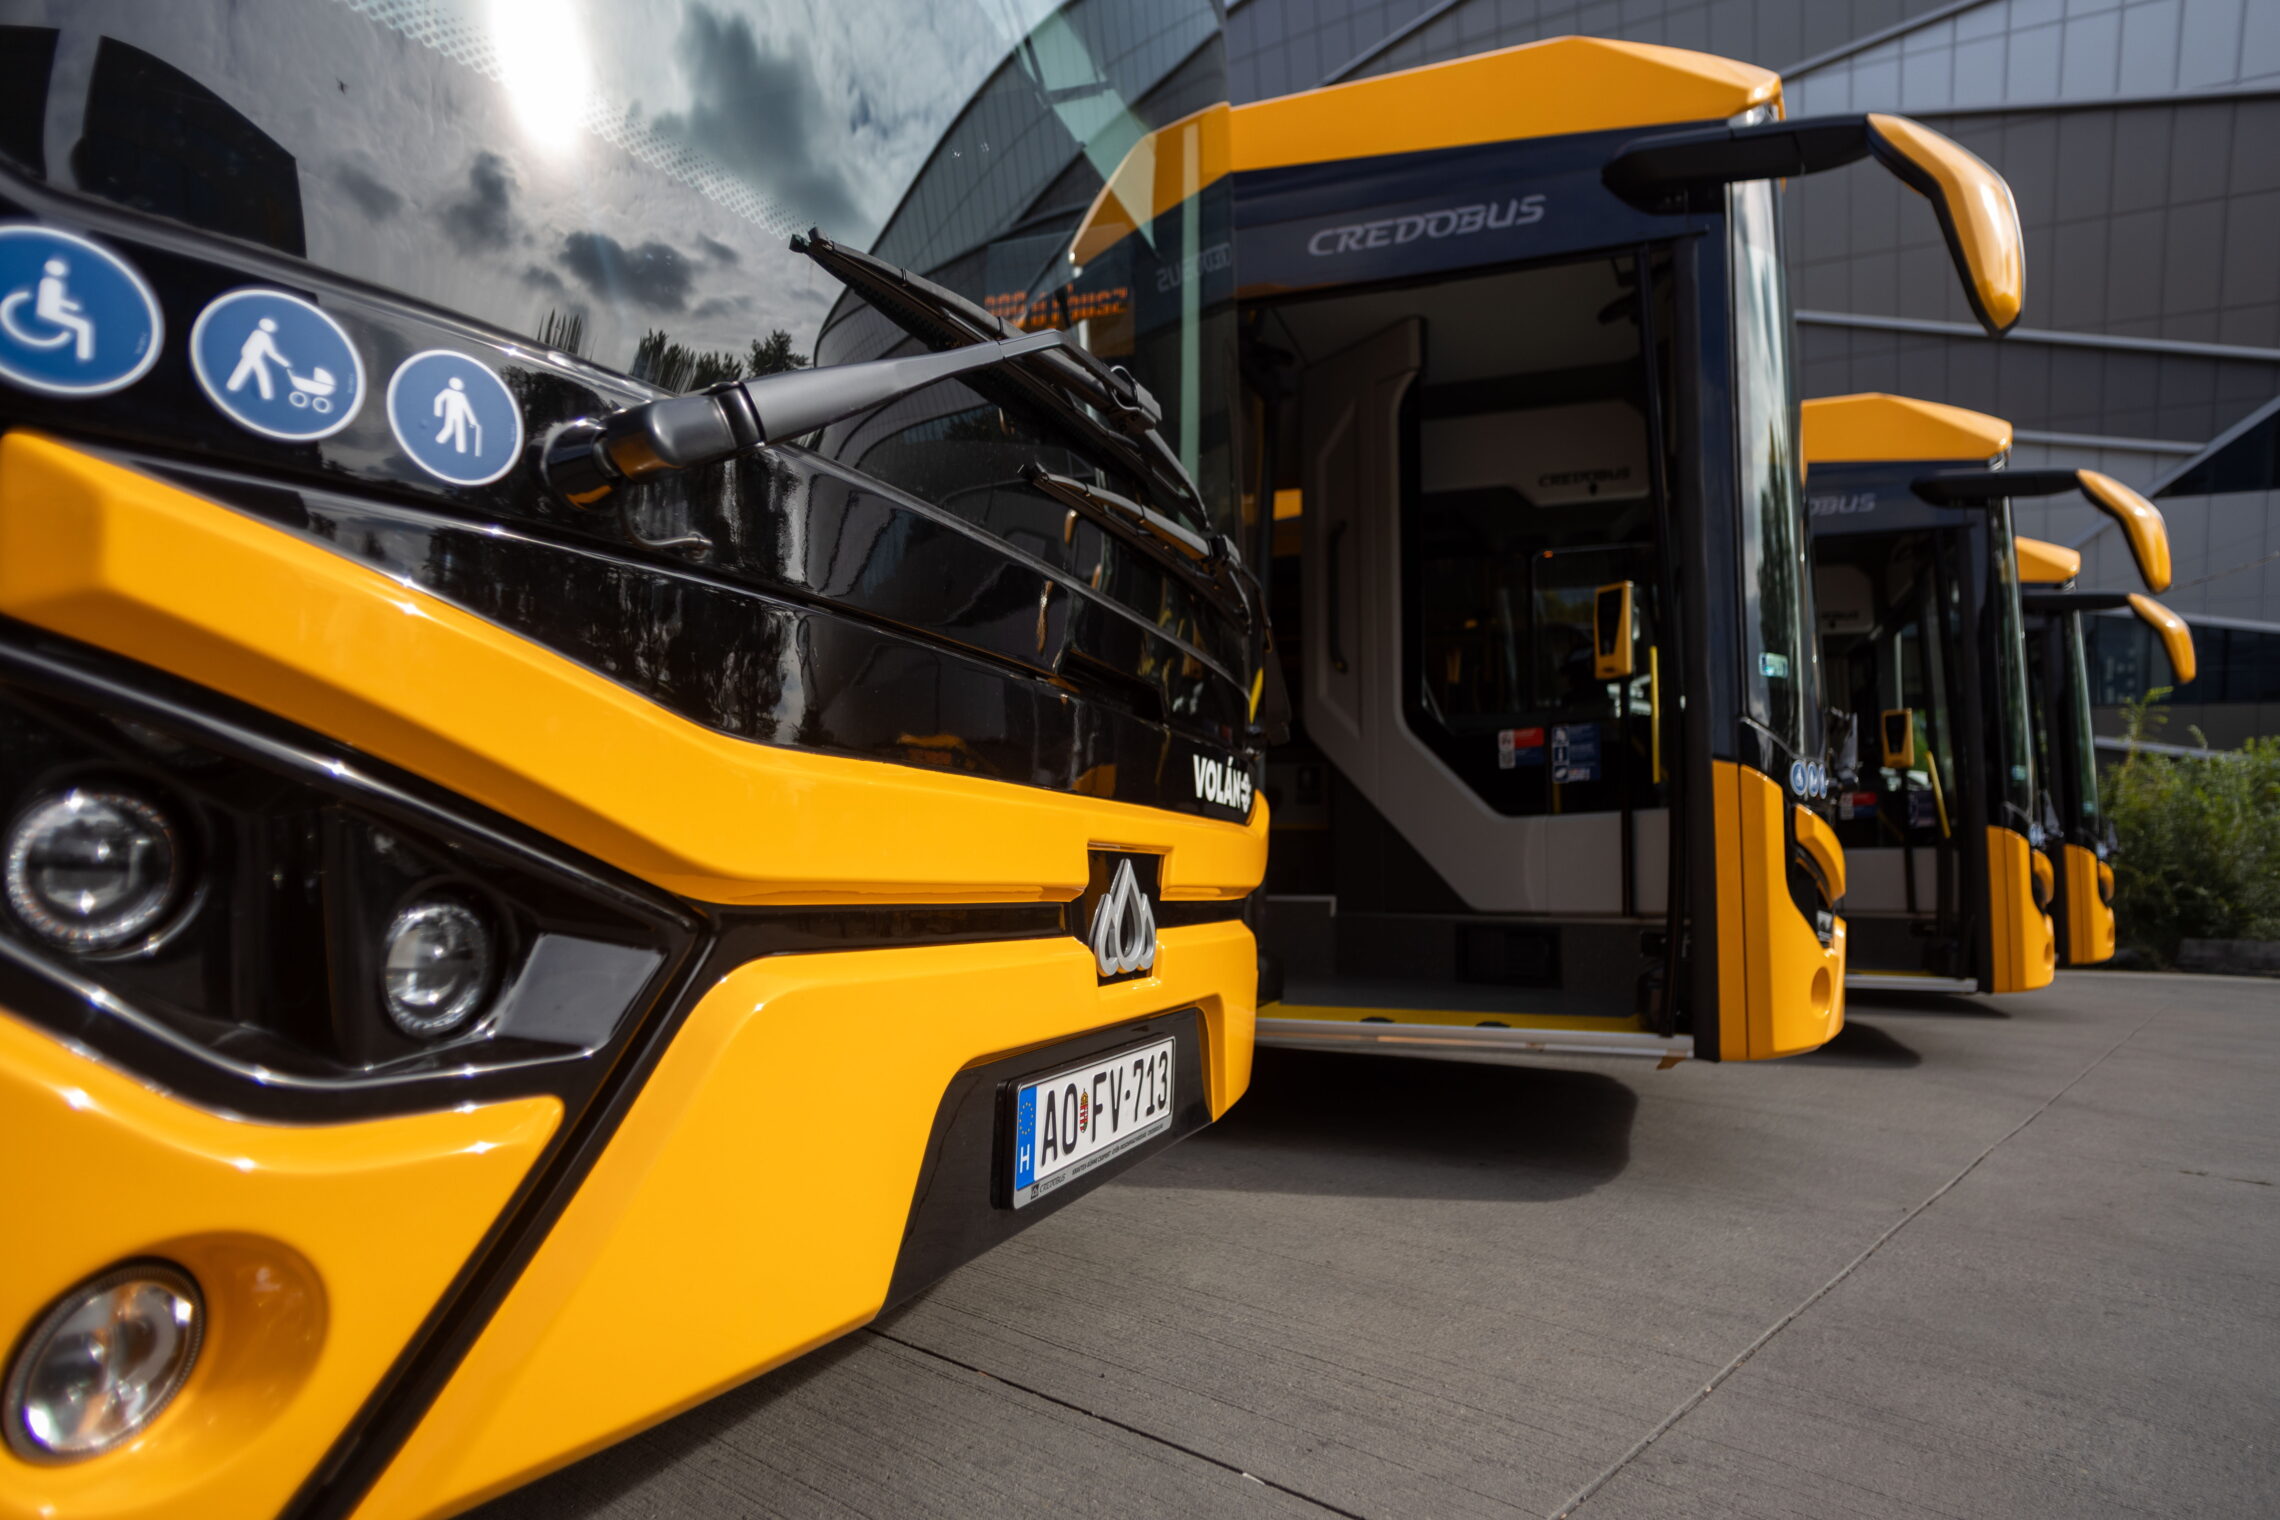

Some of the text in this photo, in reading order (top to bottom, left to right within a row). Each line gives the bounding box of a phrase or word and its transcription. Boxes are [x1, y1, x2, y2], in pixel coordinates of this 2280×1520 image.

[1307, 194, 1547, 256] CREDOBUS
[1193, 753, 1242, 809] VOLÁN
[1041, 1083, 1078, 1168] AO
[1019, 1143, 1030, 1174] H
